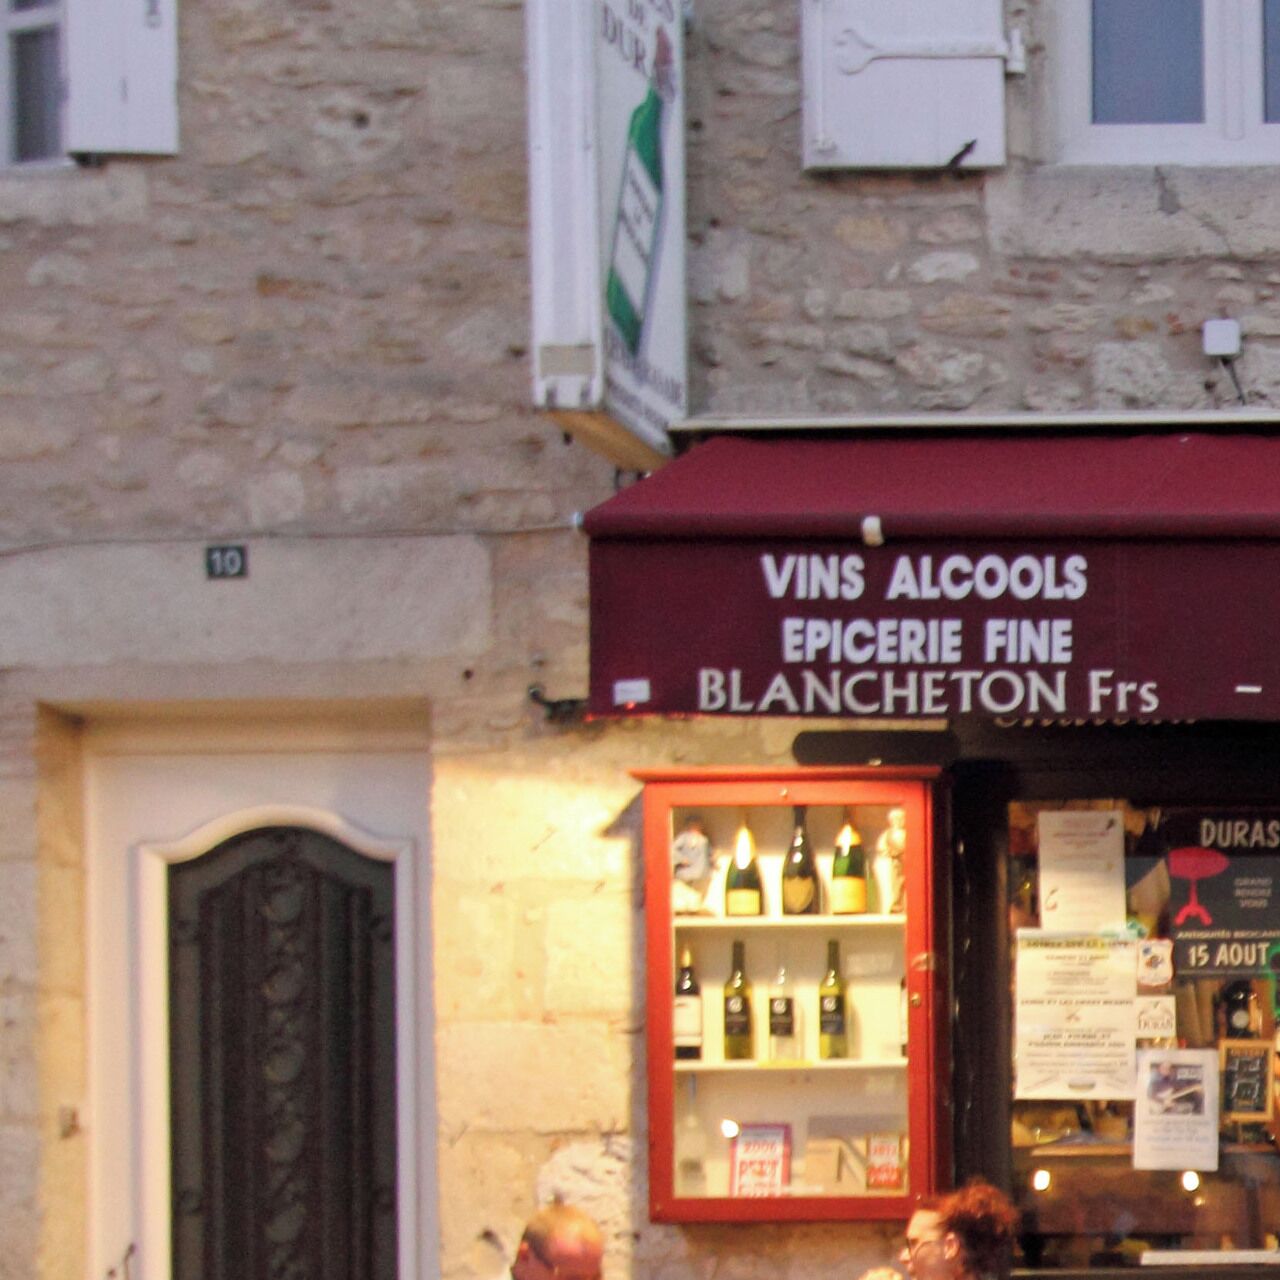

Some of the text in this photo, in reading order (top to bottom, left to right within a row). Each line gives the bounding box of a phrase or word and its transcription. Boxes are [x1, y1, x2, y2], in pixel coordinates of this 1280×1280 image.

[212, 550, 242, 575] 10
[761, 554, 1088, 600] VINS ALCOOLS
[782, 617, 1072, 664] EPICERIE FINE
[699, 668, 1068, 714] BLANCHETON
[1089, 669, 1159, 712] Frs
[1201, 818, 1280, 848] DURAS
[1188, 941, 1270, 968] 15 AOUT
